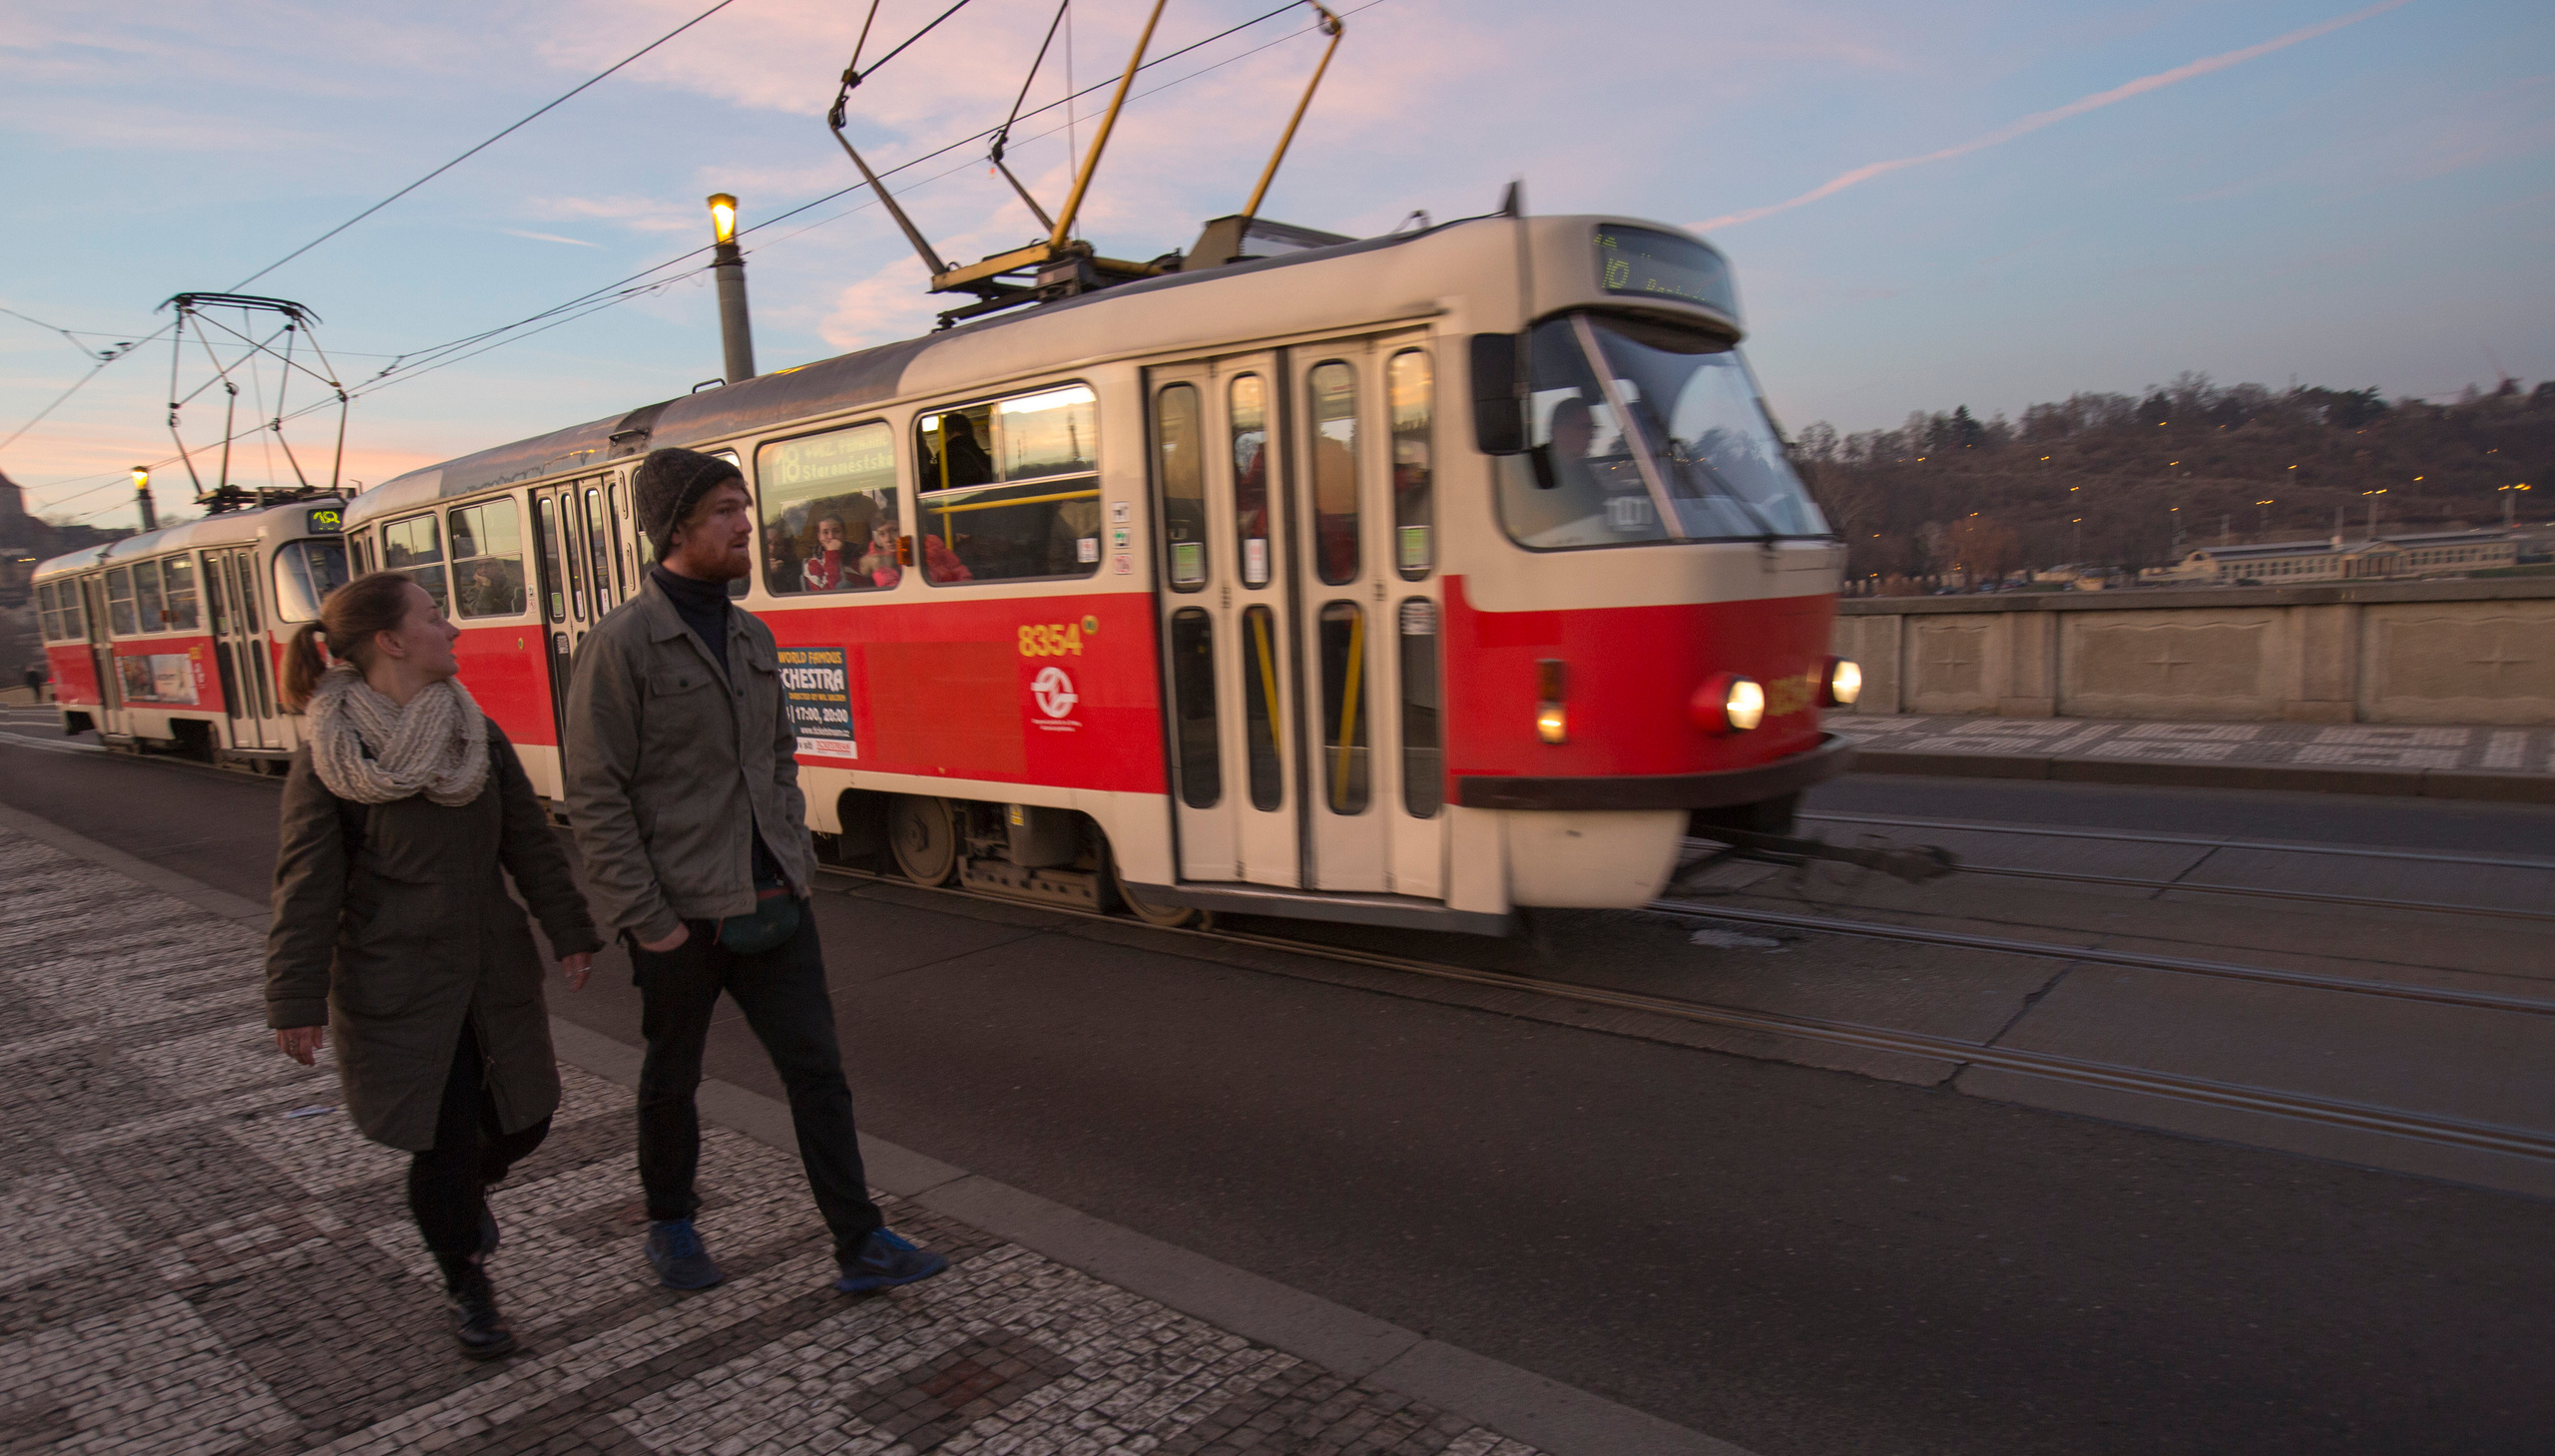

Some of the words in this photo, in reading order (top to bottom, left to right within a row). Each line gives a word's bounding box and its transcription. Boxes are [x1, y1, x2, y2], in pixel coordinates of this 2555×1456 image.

[1017, 623, 1085, 658] 8354
[777, 652, 806, 664] WORLD
[808, 652, 842, 664] FAMOUS
[777, 669, 845, 692] CHESTRA
[822, 708, 848, 723] 20:00
